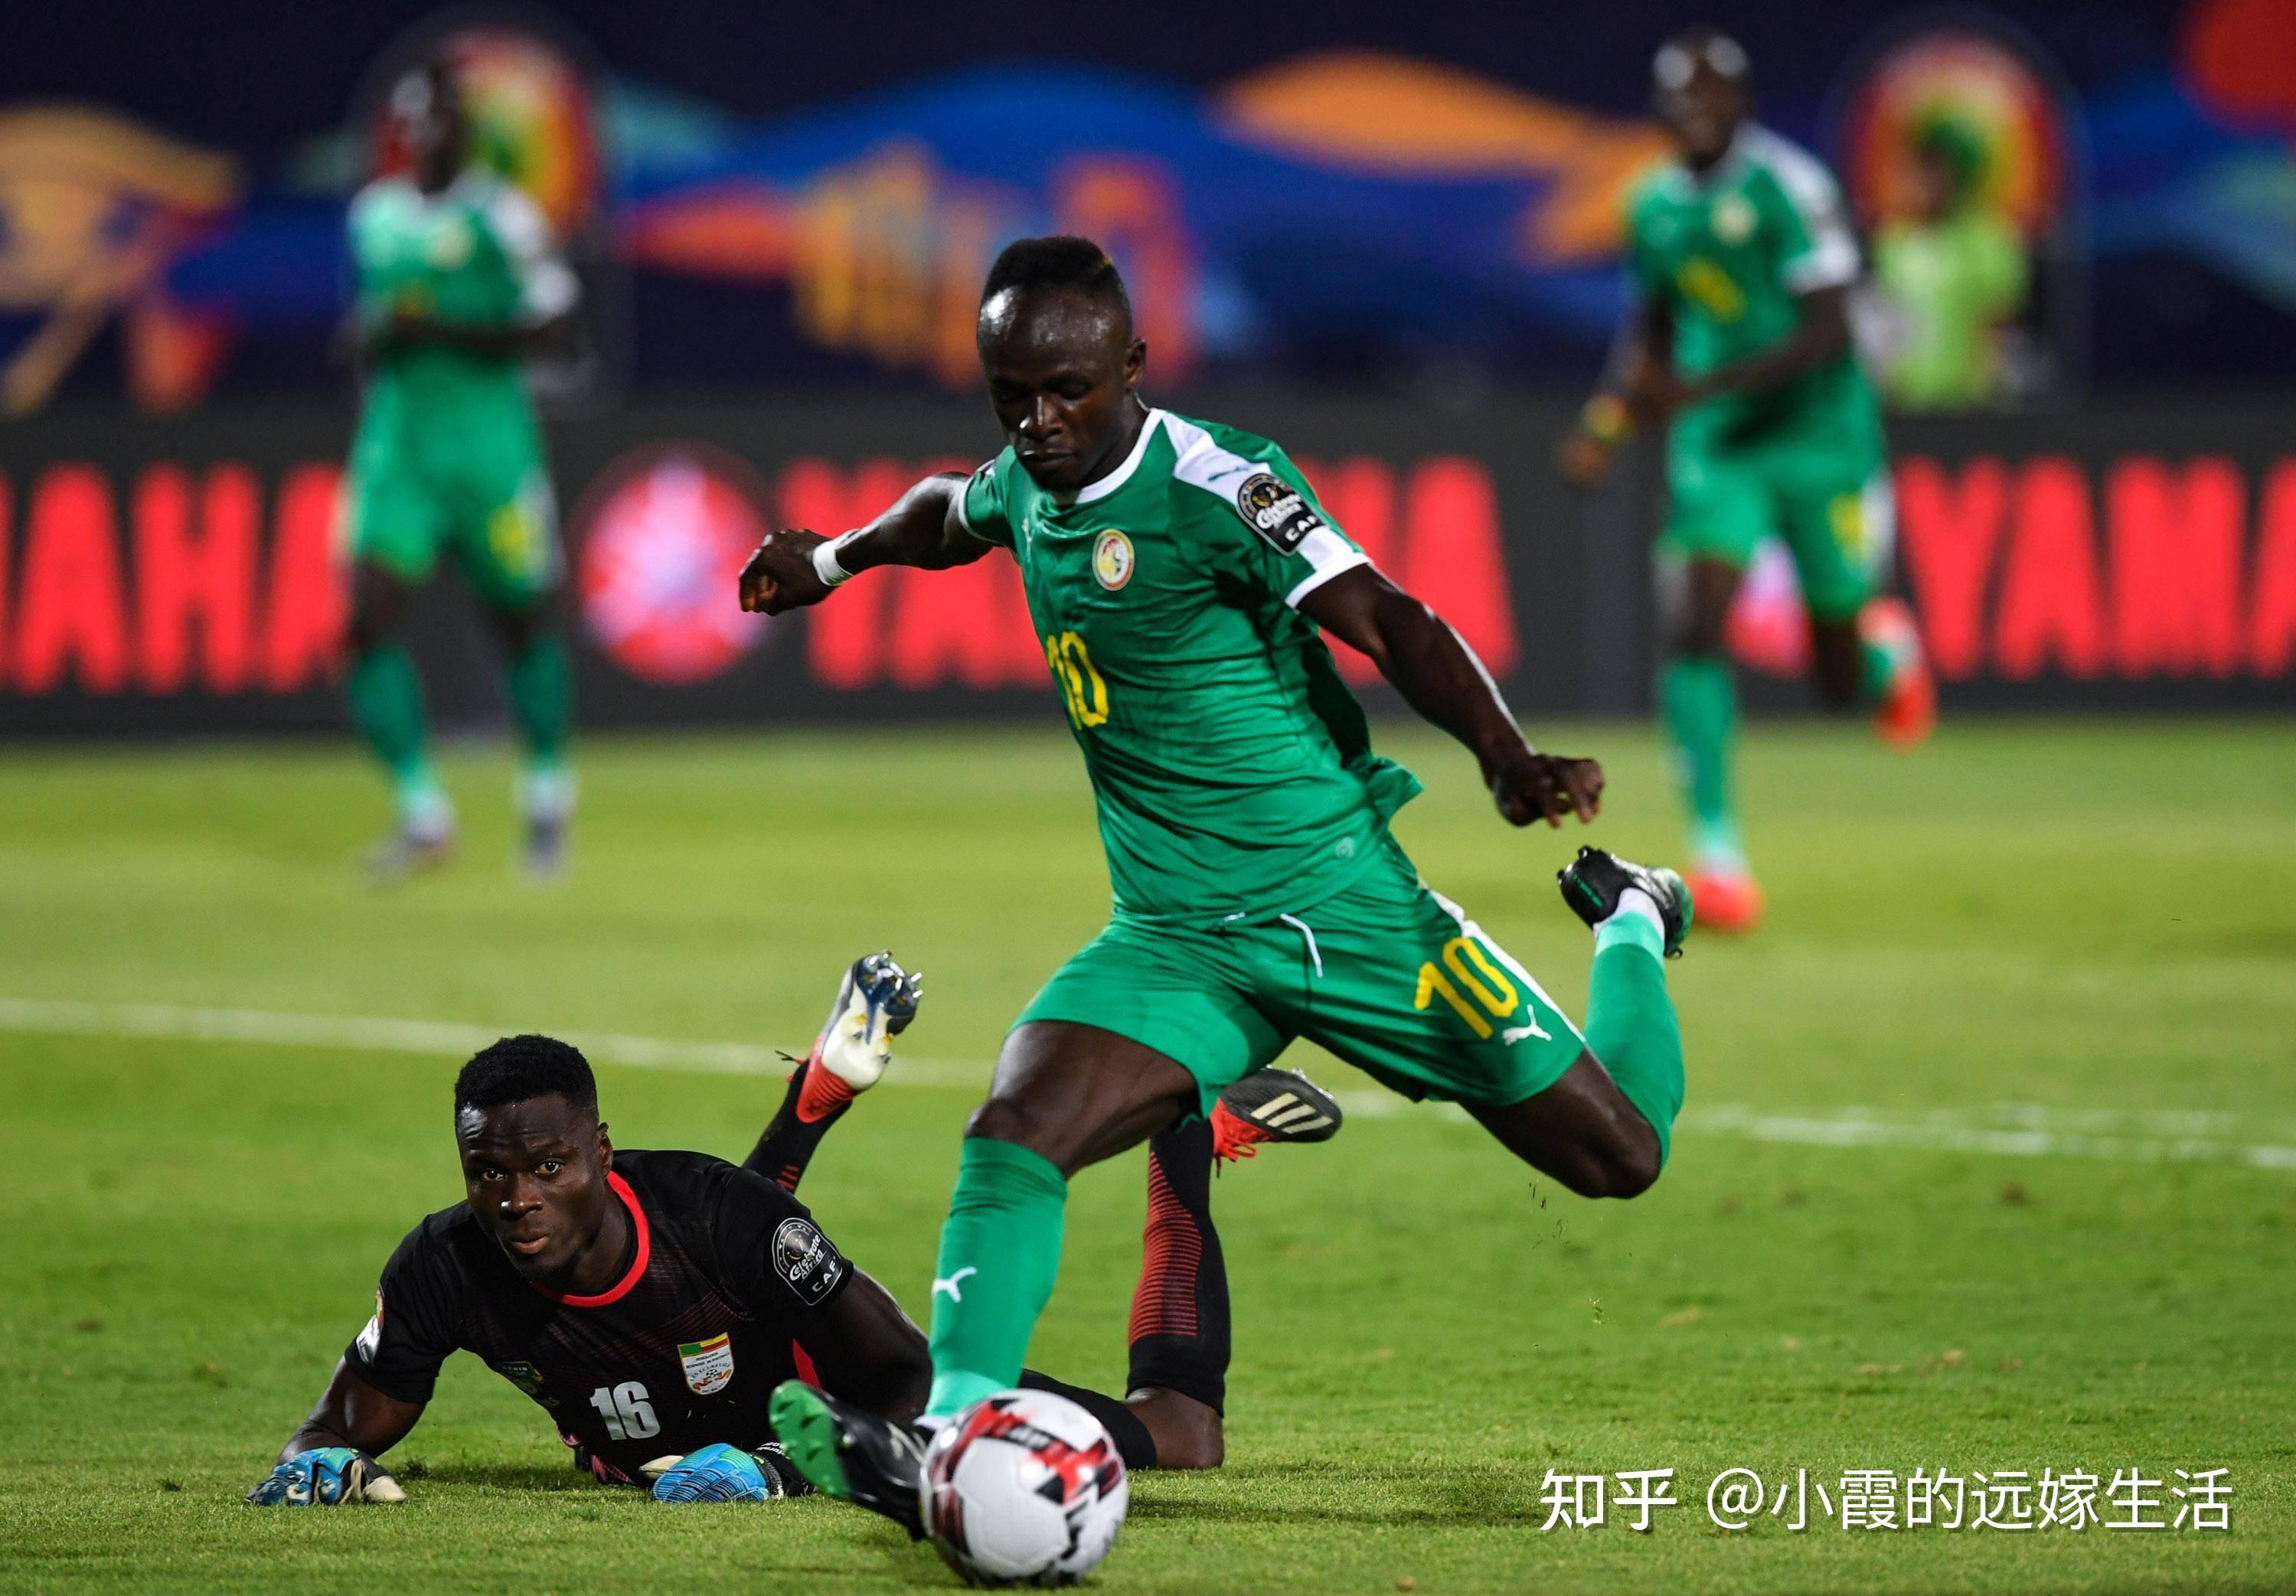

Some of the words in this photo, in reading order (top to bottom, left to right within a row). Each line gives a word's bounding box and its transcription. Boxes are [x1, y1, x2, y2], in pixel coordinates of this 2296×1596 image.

[0, 463, 351, 695] AHA
[1047, 632, 1109, 730] 10
[1413, 937, 1518, 1040] 10
[789, 1234, 821, 1281] Celebrate
[812, 1260, 836, 1292] CAF
[590, 1381, 661, 1440] 16
